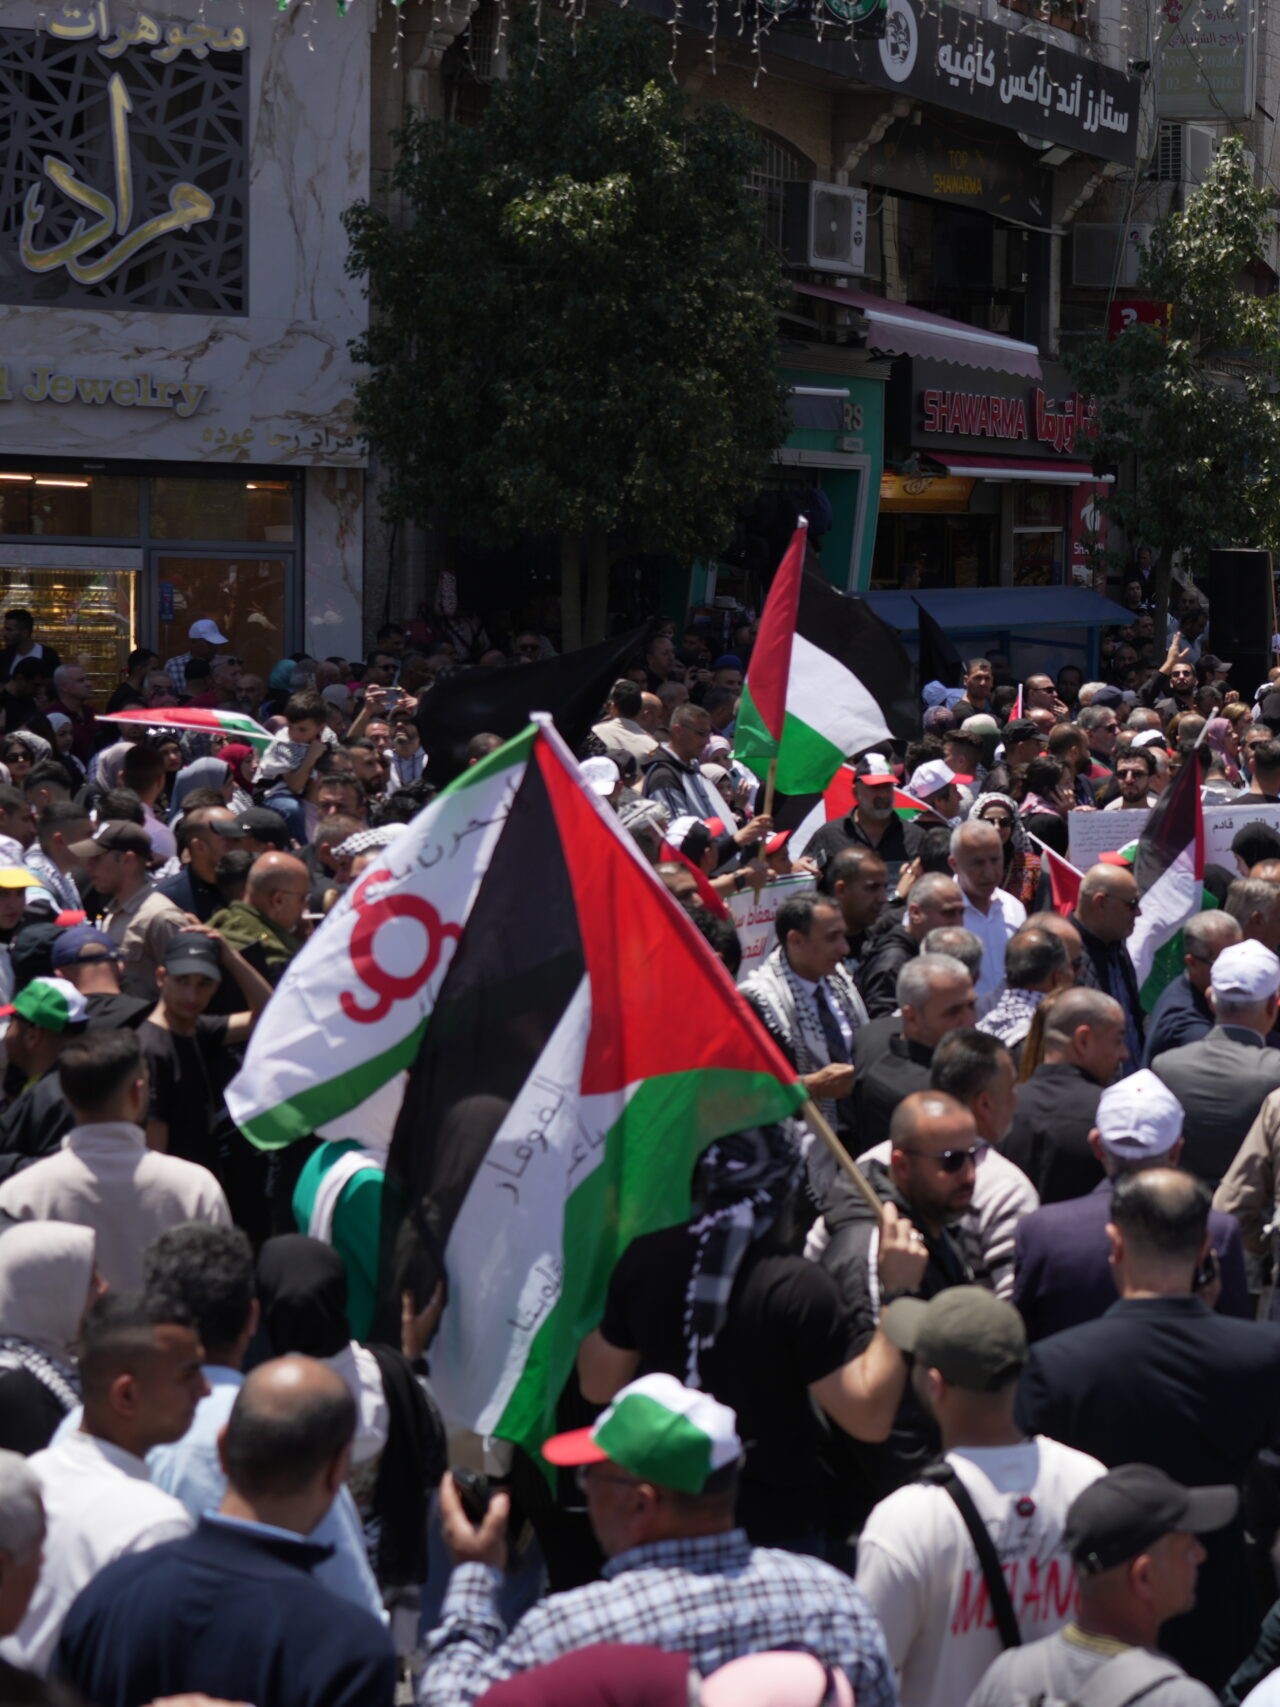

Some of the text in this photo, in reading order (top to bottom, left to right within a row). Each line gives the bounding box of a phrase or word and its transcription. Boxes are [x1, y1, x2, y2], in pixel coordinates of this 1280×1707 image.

[47, 0, 249, 63] مجوهرات
[938, 43, 1129, 134] ستارز آند باكس كافيه
[20, 72, 216, 285] مراد
[933, 173, 984, 195] SHAWARMA
[24, 363, 207, 418] Jewelry
[921, 388, 1028, 441] SHAWARMA
[1212, 817, 1234, 833] قادم
